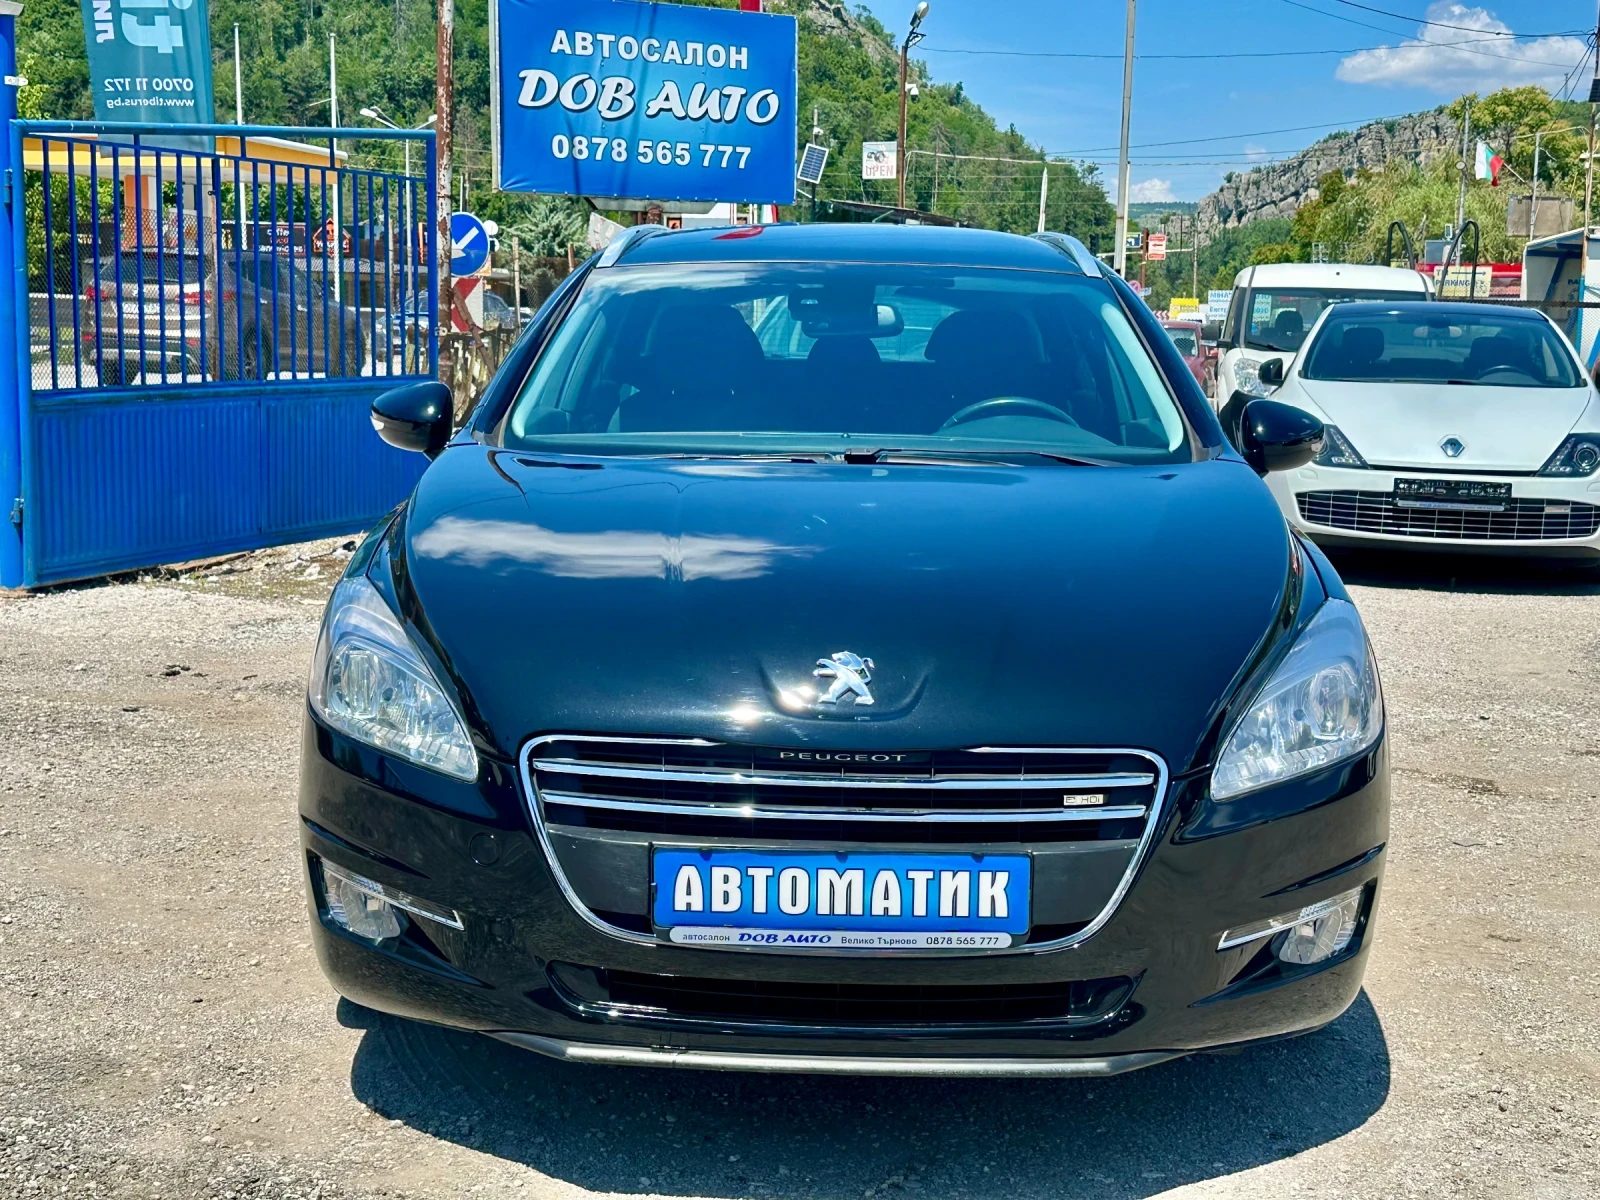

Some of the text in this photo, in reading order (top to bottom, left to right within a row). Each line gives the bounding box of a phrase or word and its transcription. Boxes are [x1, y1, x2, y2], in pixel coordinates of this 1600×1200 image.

[550, 30, 748, 70] АВТОСАЛОН
[517, 69, 780, 124] DOB AUTO
[551, 134, 752, 169] 0878 565 777
[865, 165, 894, 177] OPEN
[780, 751, 907, 762] PEUGEOT
[673, 864, 1010, 919] АВТОМАТИК
[682, 932, 1000, 947] автосалон DOB AUTO Велико Търново 0878 565 777
